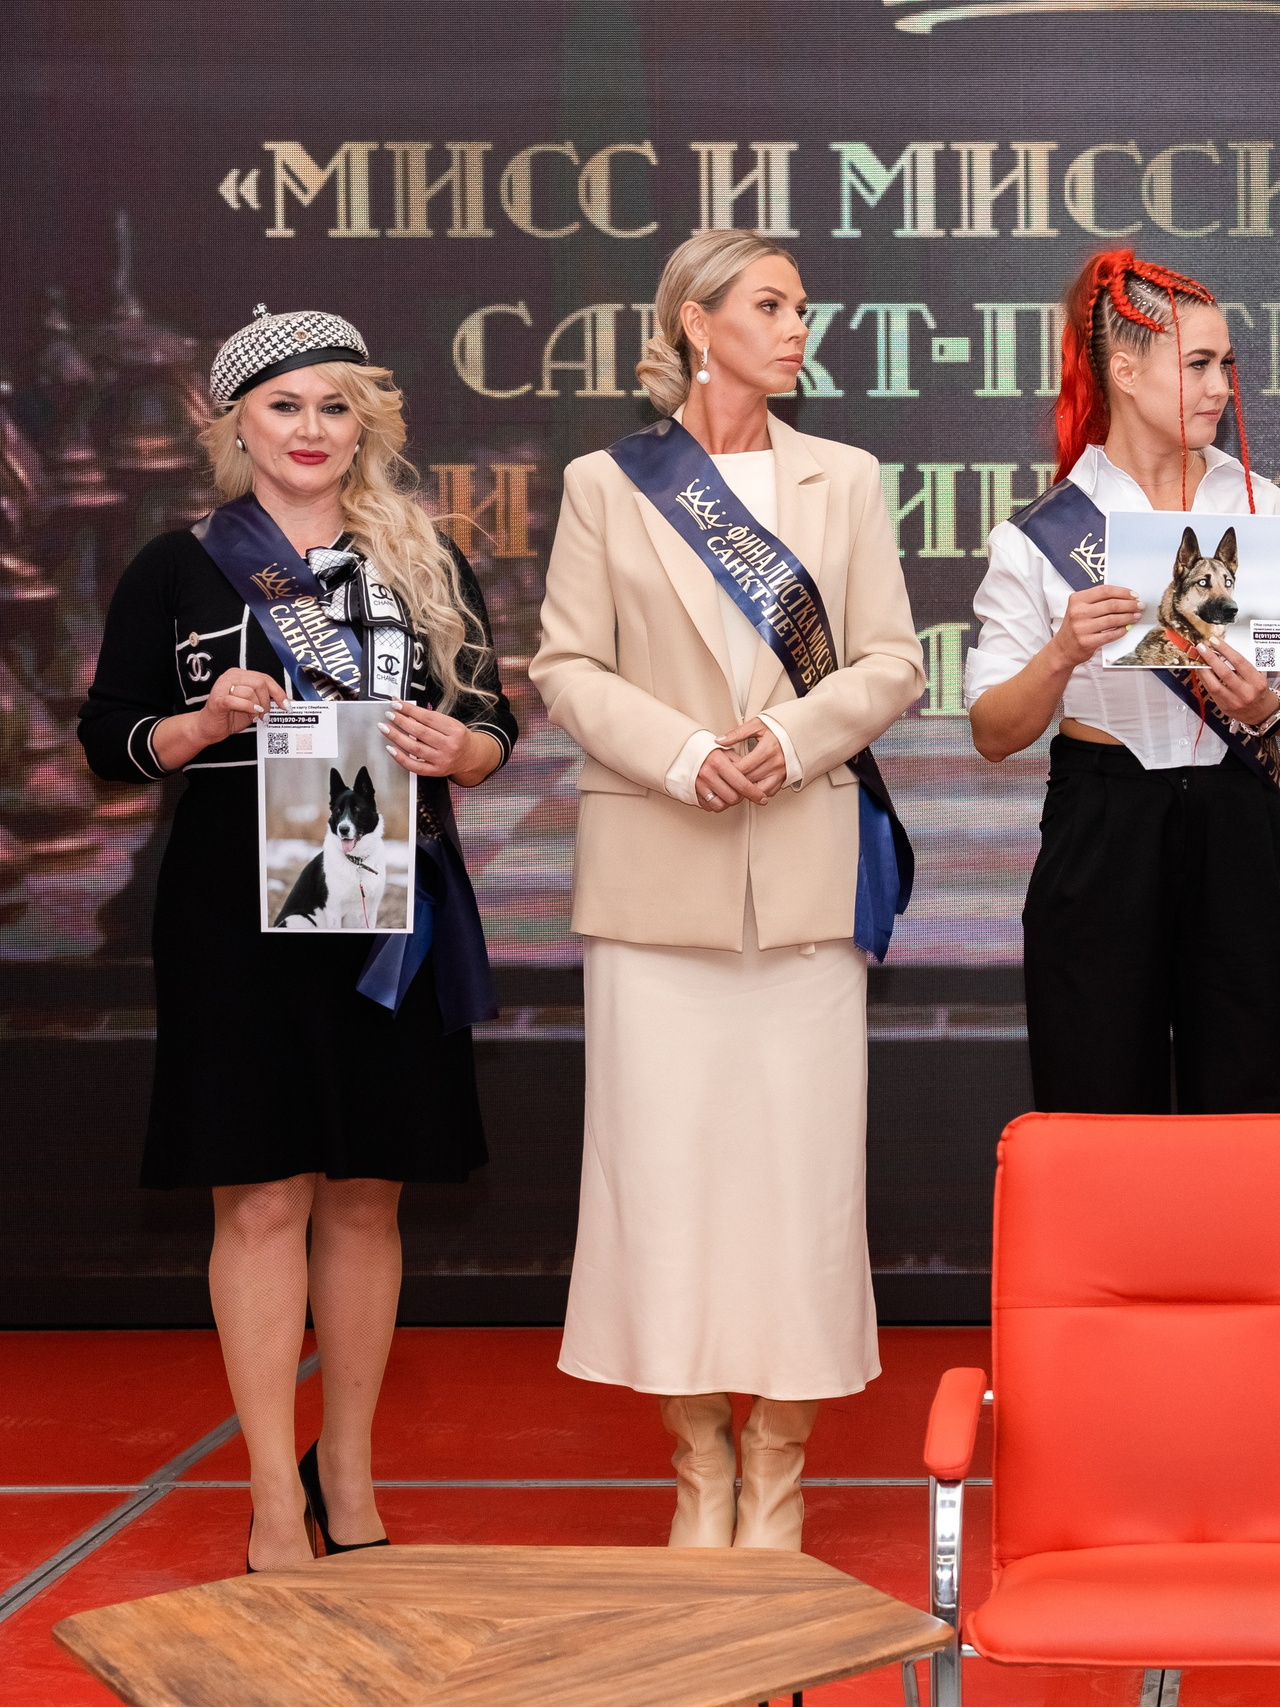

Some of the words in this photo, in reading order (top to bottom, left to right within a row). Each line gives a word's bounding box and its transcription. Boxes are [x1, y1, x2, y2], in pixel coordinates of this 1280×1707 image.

[217, 139, 660, 239] «МИСС
[689, 140, 799, 239] И
[725, 525, 819, 635] ФИНАЛИСТКА
[376, 673, 399, 686] CHANEL
